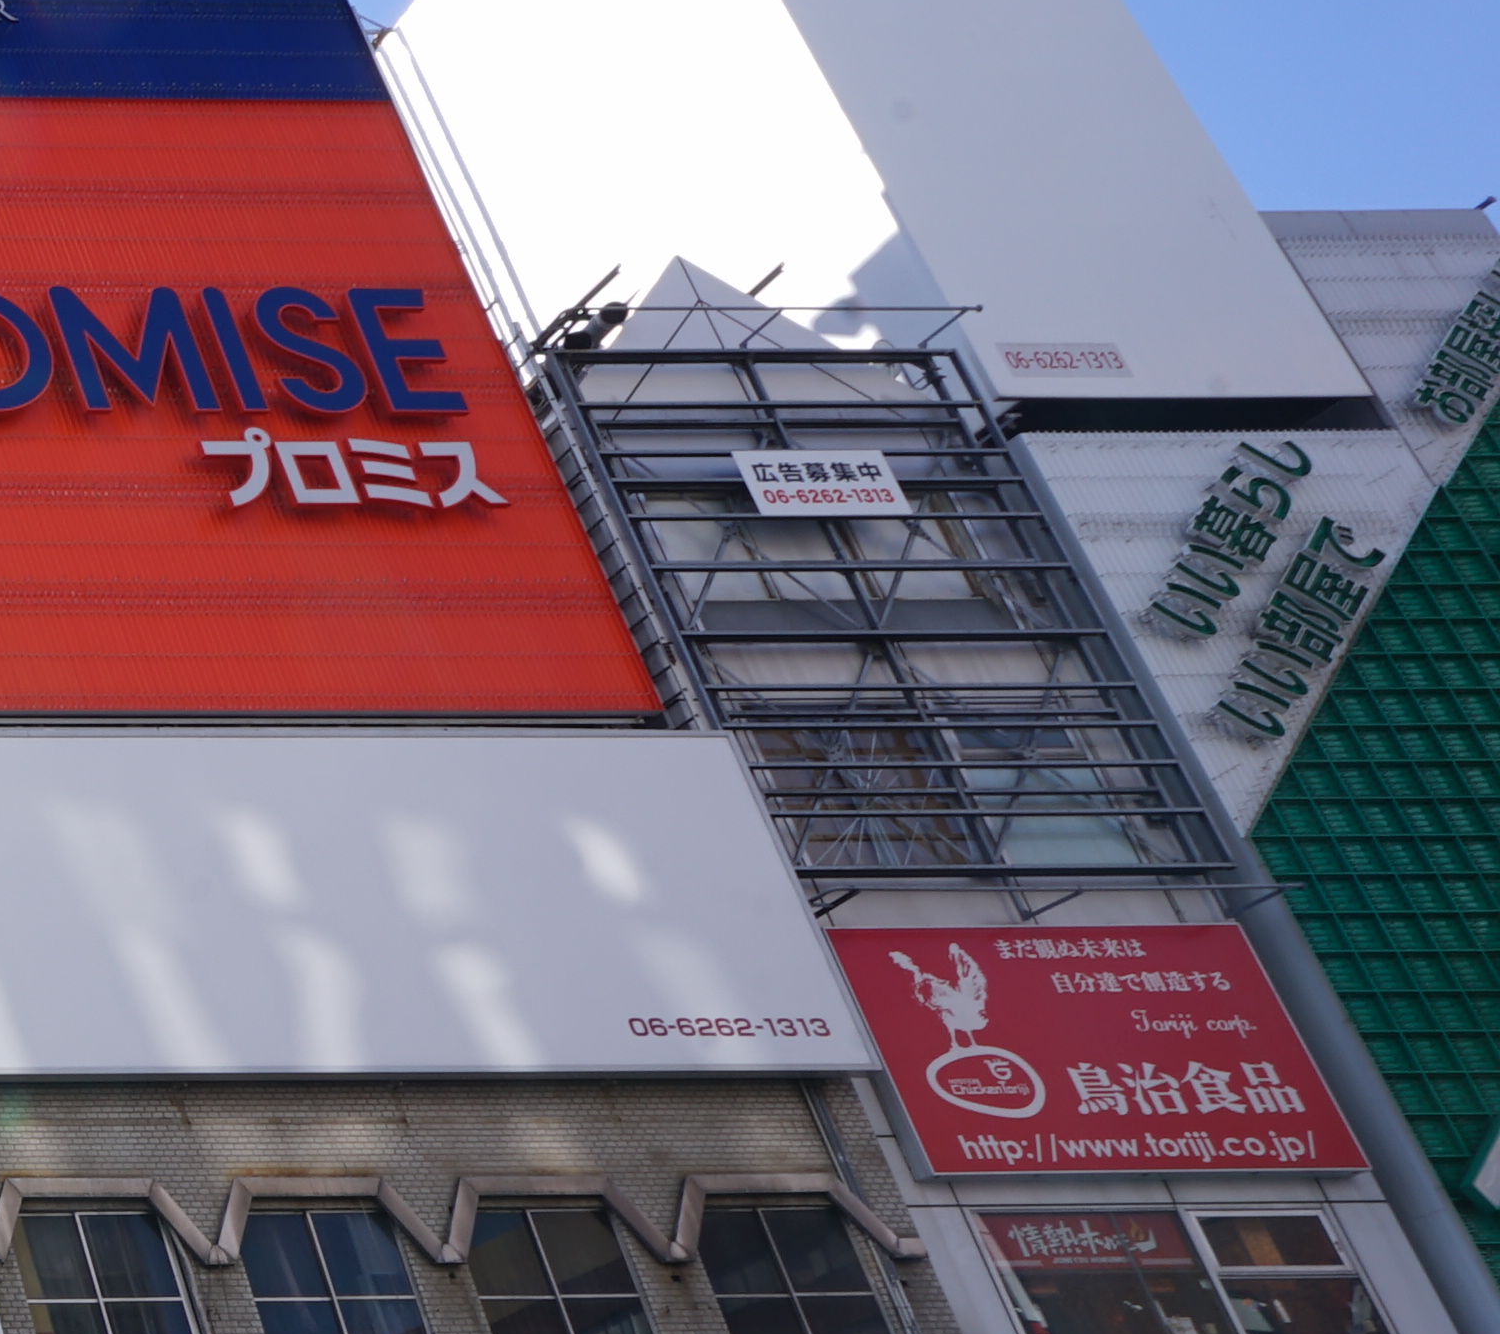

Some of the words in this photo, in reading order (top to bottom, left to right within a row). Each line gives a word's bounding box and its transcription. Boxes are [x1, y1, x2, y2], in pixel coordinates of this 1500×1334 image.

[1006, 347, 1125, 372] 06-6262-1313
[201, 426, 510, 509] プロミス
[752, 461, 883, 485] 広告募集中
[763, 487, 896, 507] 06-6262-1313
[1150, 440, 1313, 636] いい暮らし
[1216, 515, 1387, 738] いい部屋で
[627, 1017, 831, 1039] 06-6262-1313
[1067, 1061, 1306, 1116] 鳥治食品
[957, 1130, 1317, 1166] http://www.toriji.co.jp/
